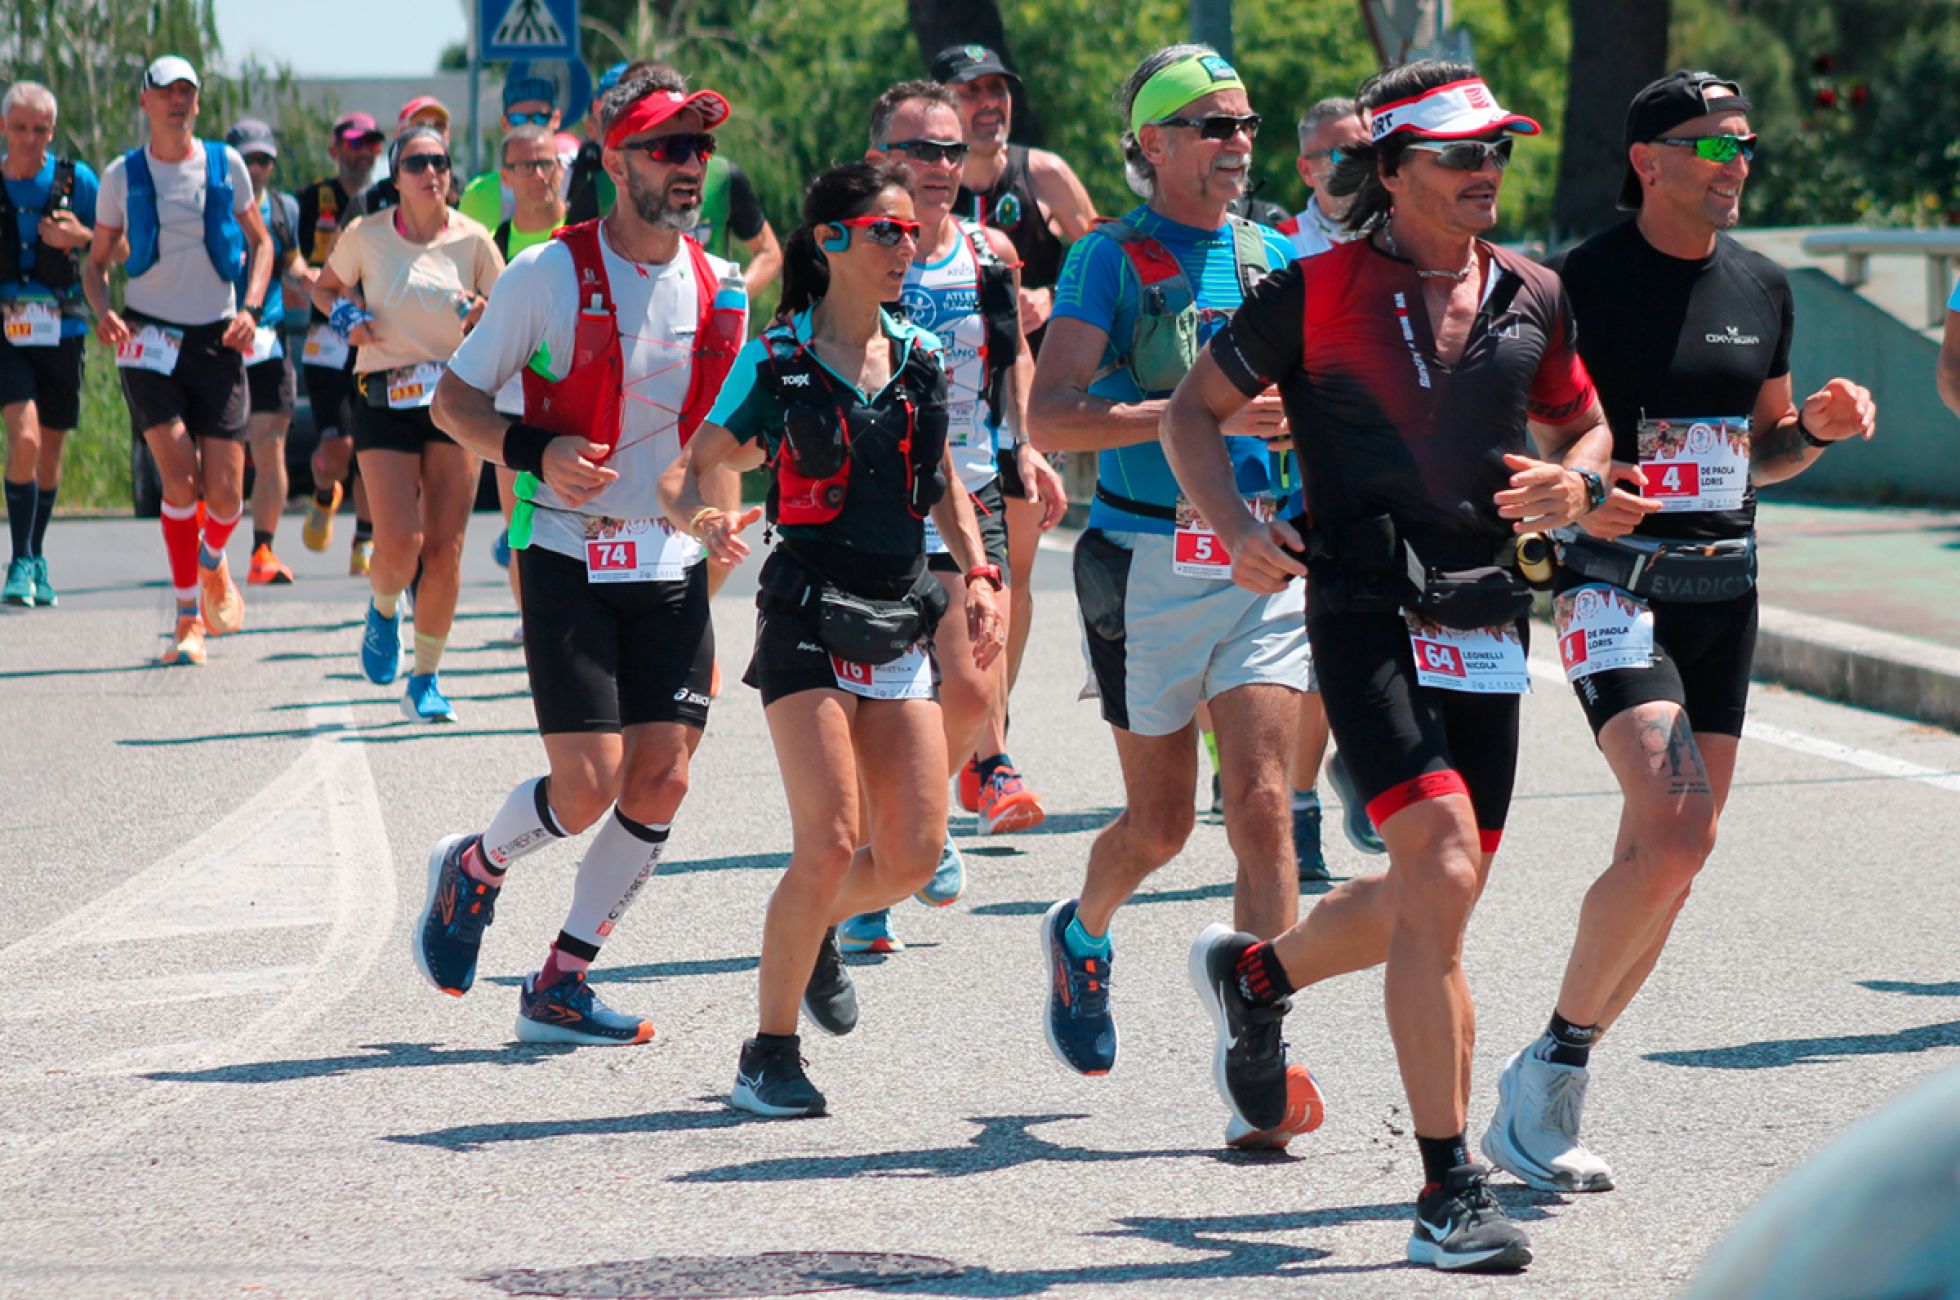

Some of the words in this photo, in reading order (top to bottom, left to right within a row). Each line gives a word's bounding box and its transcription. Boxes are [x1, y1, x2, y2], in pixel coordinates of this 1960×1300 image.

[1700, 467, 1711, 475] DE
[1713, 466, 1736, 475] PAOLA
[1662, 466, 1681, 491] 4
[1701, 477, 1724, 486] LORIS
[1195, 536, 1213, 560] 5
[597, 543, 627, 566] 74
[1587, 630, 1598, 639] DE
[1600, 626, 1630, 636] PAOLA
[1588, 638, 1613, 649] LORIS
[1425, 644, 1455, 670] 64
[1463, 650, 1504, 660] LEONELLI
[1465, 661, 1497, 670] NICOLA
